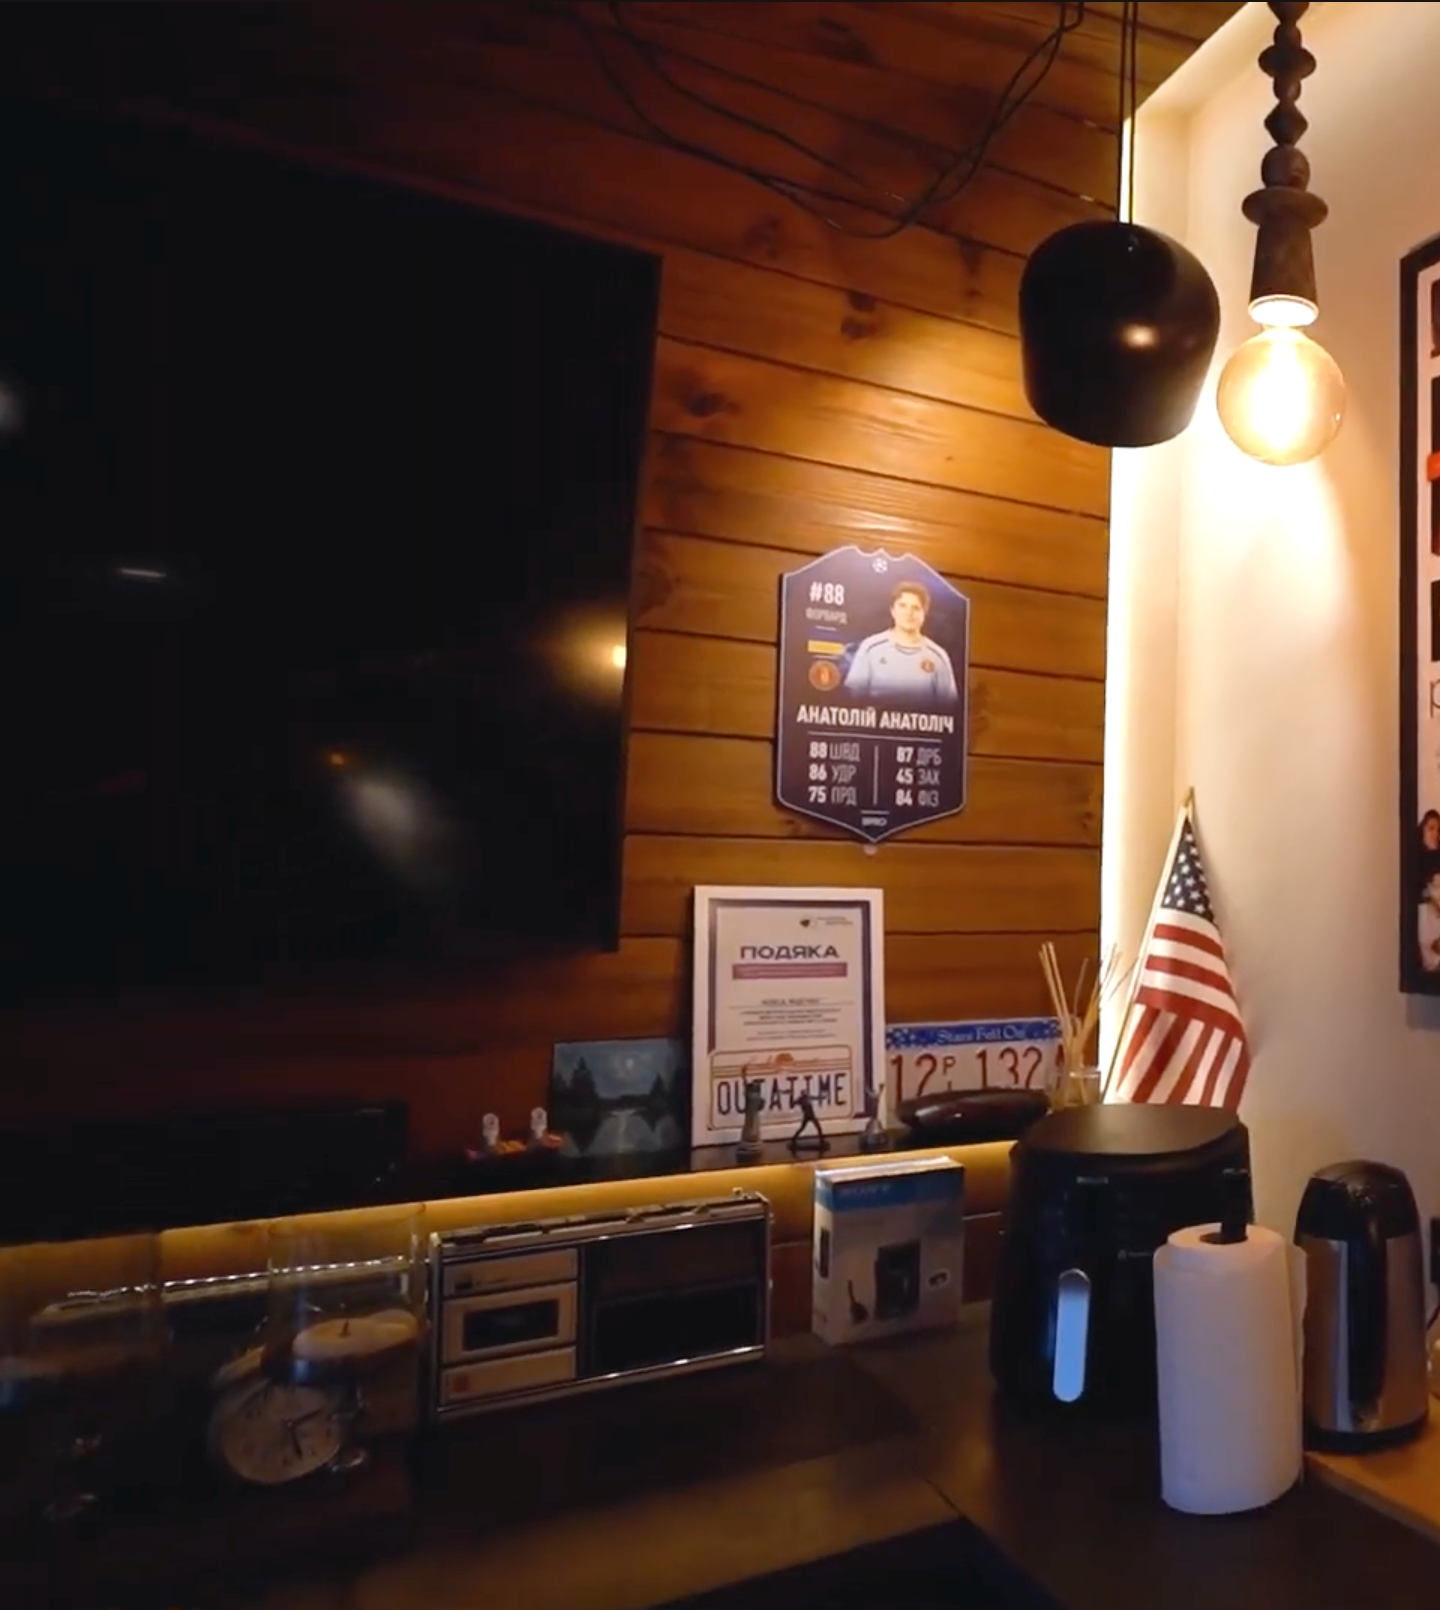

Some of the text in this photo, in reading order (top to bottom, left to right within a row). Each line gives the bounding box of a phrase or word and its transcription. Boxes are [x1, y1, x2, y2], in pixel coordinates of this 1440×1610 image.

[809, 581, 845, 606] #88
[796, 704, 954, 734] АНАТОЛІЙ АНАТОЛІЧ
[809, 741, 860, 762] 88 ШВД
[896, 746, 914, 763] 87
[808, 764, 857, 784] 86 УДР
[896, 768, 914, 785] 45
[808, 786, 857, 806] 75 ПРД
[895, 789, 913, 806] 84
[740, 945, 840, 960] ПОДЯКА
